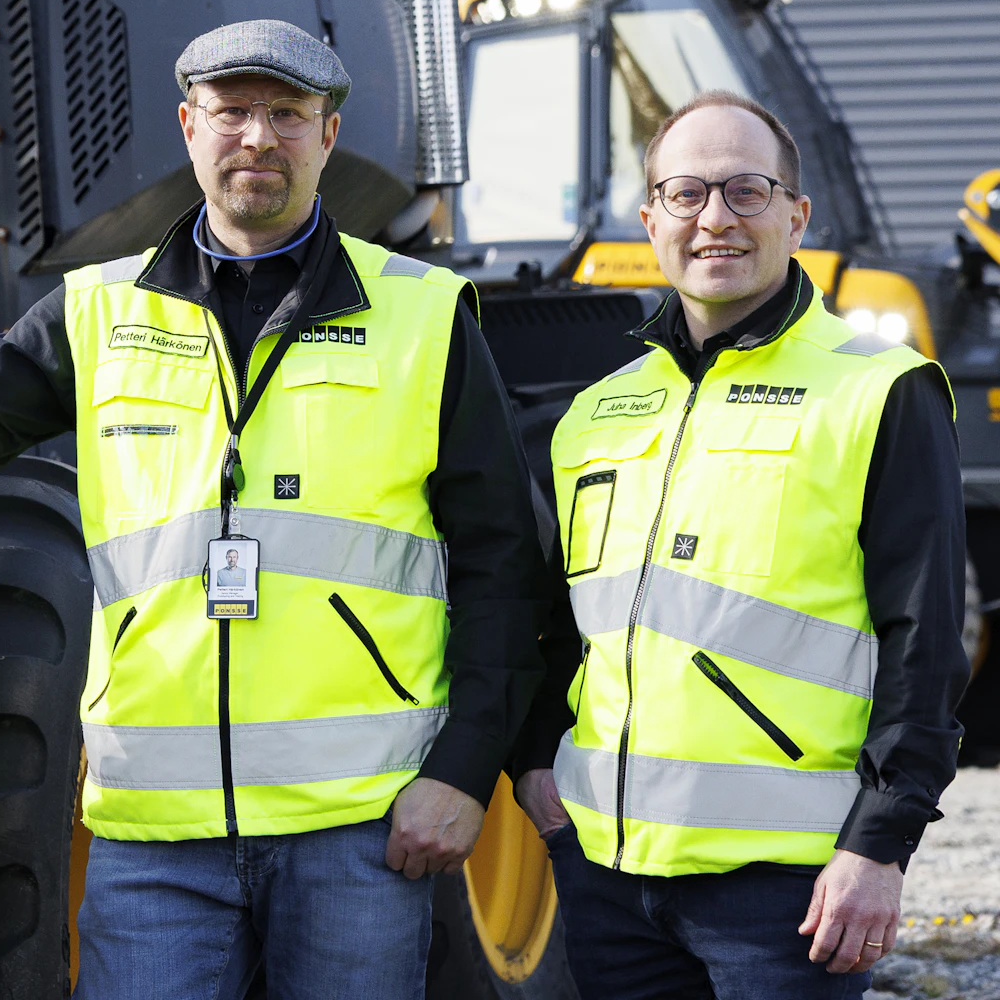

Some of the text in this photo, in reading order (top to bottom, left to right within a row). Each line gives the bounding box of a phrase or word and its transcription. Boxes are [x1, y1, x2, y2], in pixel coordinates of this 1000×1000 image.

[113, 332, 202, 352] Petteri Härkönen
[301, 332, 365, 344] ONSSE
[727, 392, 803, 404] PONSSE
